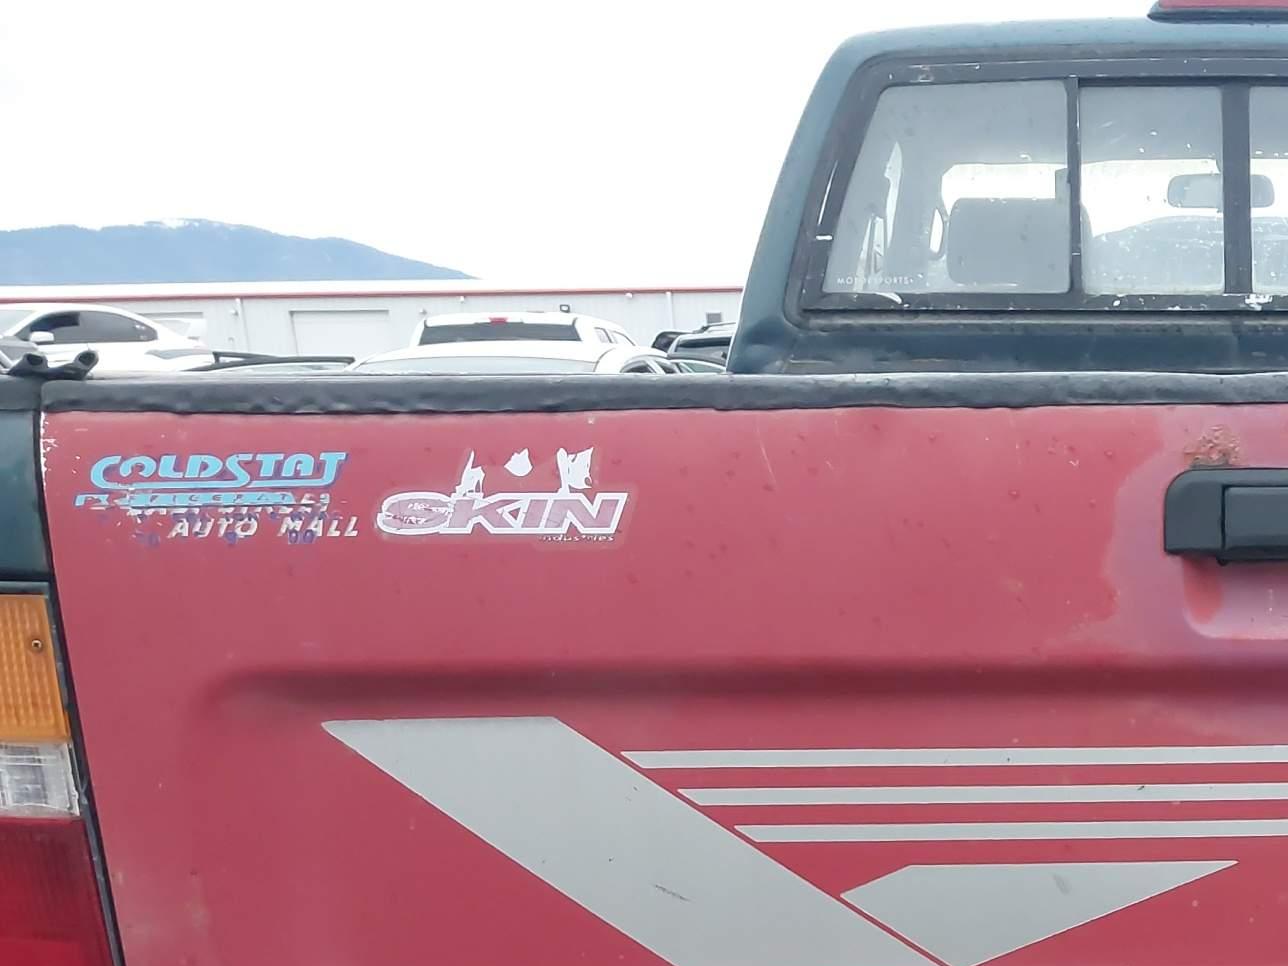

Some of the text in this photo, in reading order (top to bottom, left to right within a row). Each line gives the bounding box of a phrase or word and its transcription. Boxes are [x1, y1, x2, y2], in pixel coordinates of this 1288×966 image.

[836, 276, 911, 285] MORPORTS
[376, 491, 628, 534] SKIN
[167, 515, 358, 538] AUTO MALL
